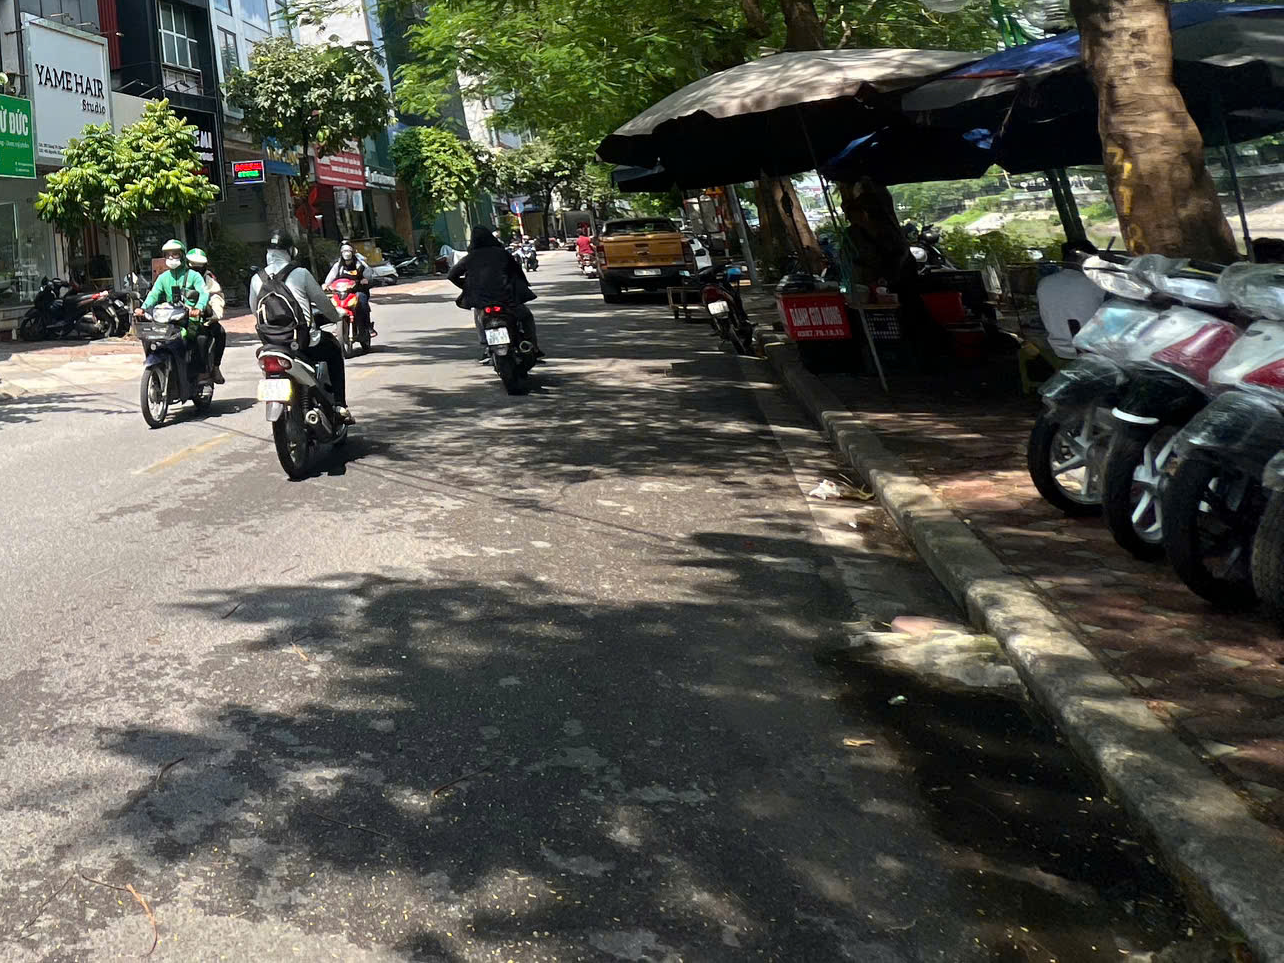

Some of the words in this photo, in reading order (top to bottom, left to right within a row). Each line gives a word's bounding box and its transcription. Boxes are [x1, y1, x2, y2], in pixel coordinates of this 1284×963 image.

[35, 63, 73, 92] YAME
[73, 73, 105, 99] HAIR
[82, 99, 106, 115] Studio
[9, 108, 29, 136] ĐỨC
